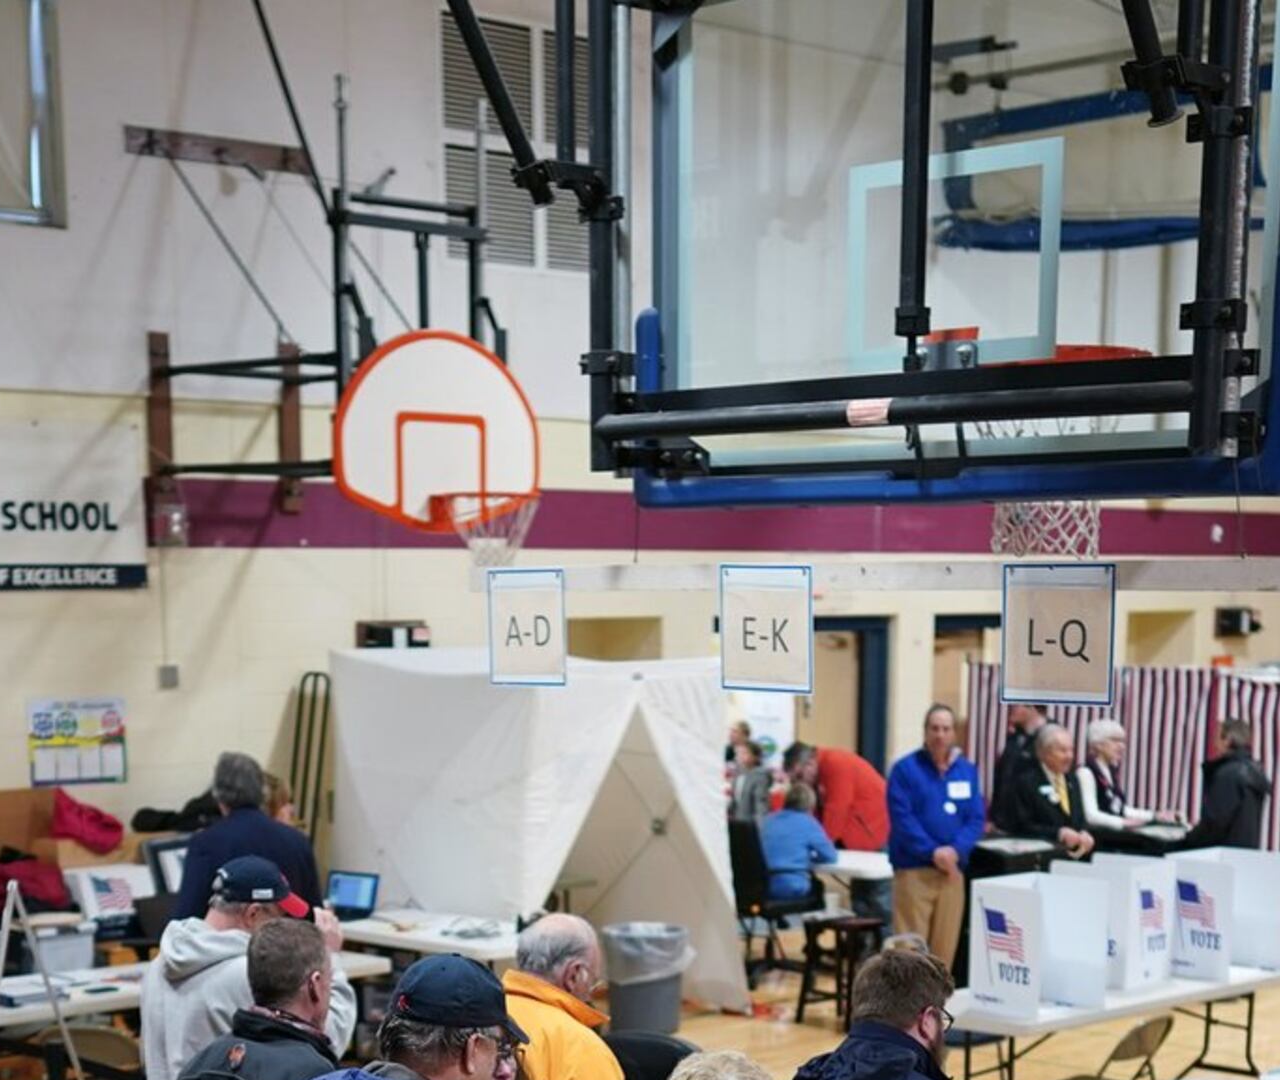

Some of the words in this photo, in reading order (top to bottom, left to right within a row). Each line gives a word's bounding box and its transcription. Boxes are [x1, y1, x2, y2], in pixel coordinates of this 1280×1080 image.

[1, 501, 119, 531] SCHOOL
[12, 568, 117, 586] EXCELLENCE
[505, 615, 551, 647] A-D
[742, 616, 790, 653] E-K
[1028, 618, 1091, 663] L-Q
[1190, 930, 1222, 950] VOTE
[998, 962, 1031, 985] VOTE
